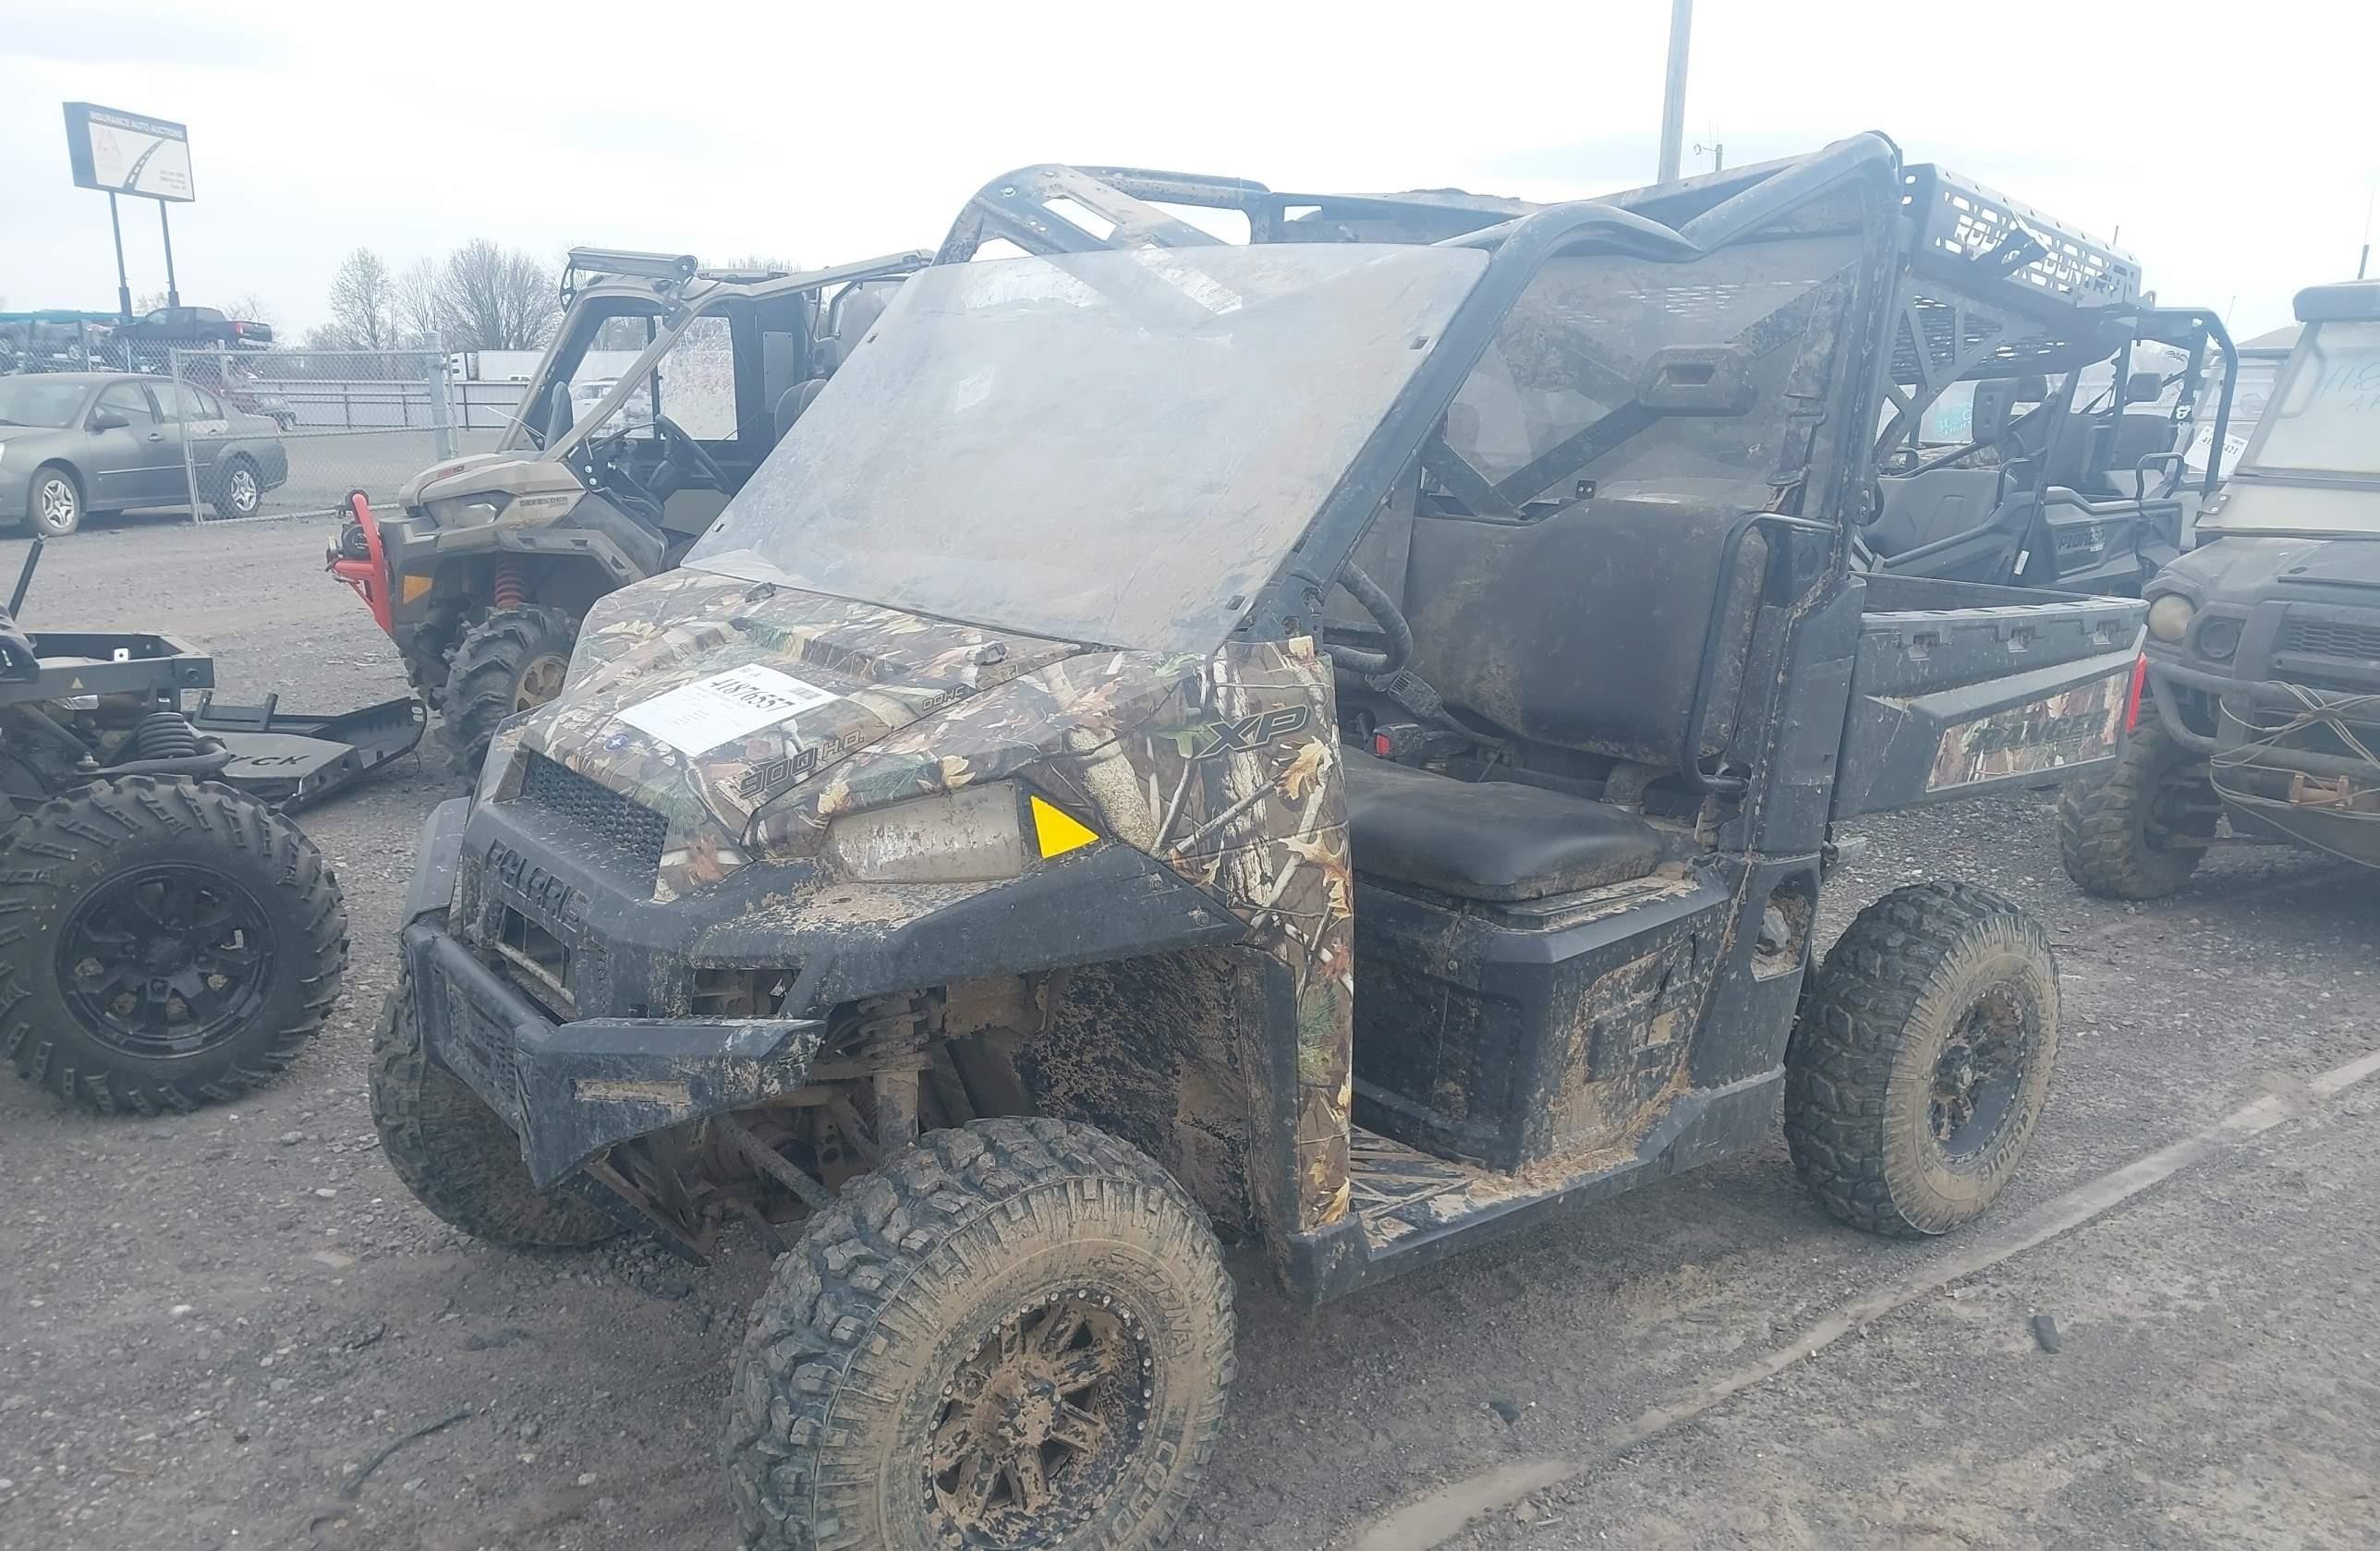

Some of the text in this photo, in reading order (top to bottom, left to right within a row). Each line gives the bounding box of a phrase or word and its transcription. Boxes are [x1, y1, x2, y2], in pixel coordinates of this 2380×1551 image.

[89, 110, 131, 127] INSURANCE
[131, 120, 150, 133] AUTO
[519, 495, 568, 507] DEFENDER
[922, 685, 966, 711] DOHC
[1194, 703, 1308, 759] XP
[484, 838, 590, 933] POLARIS
